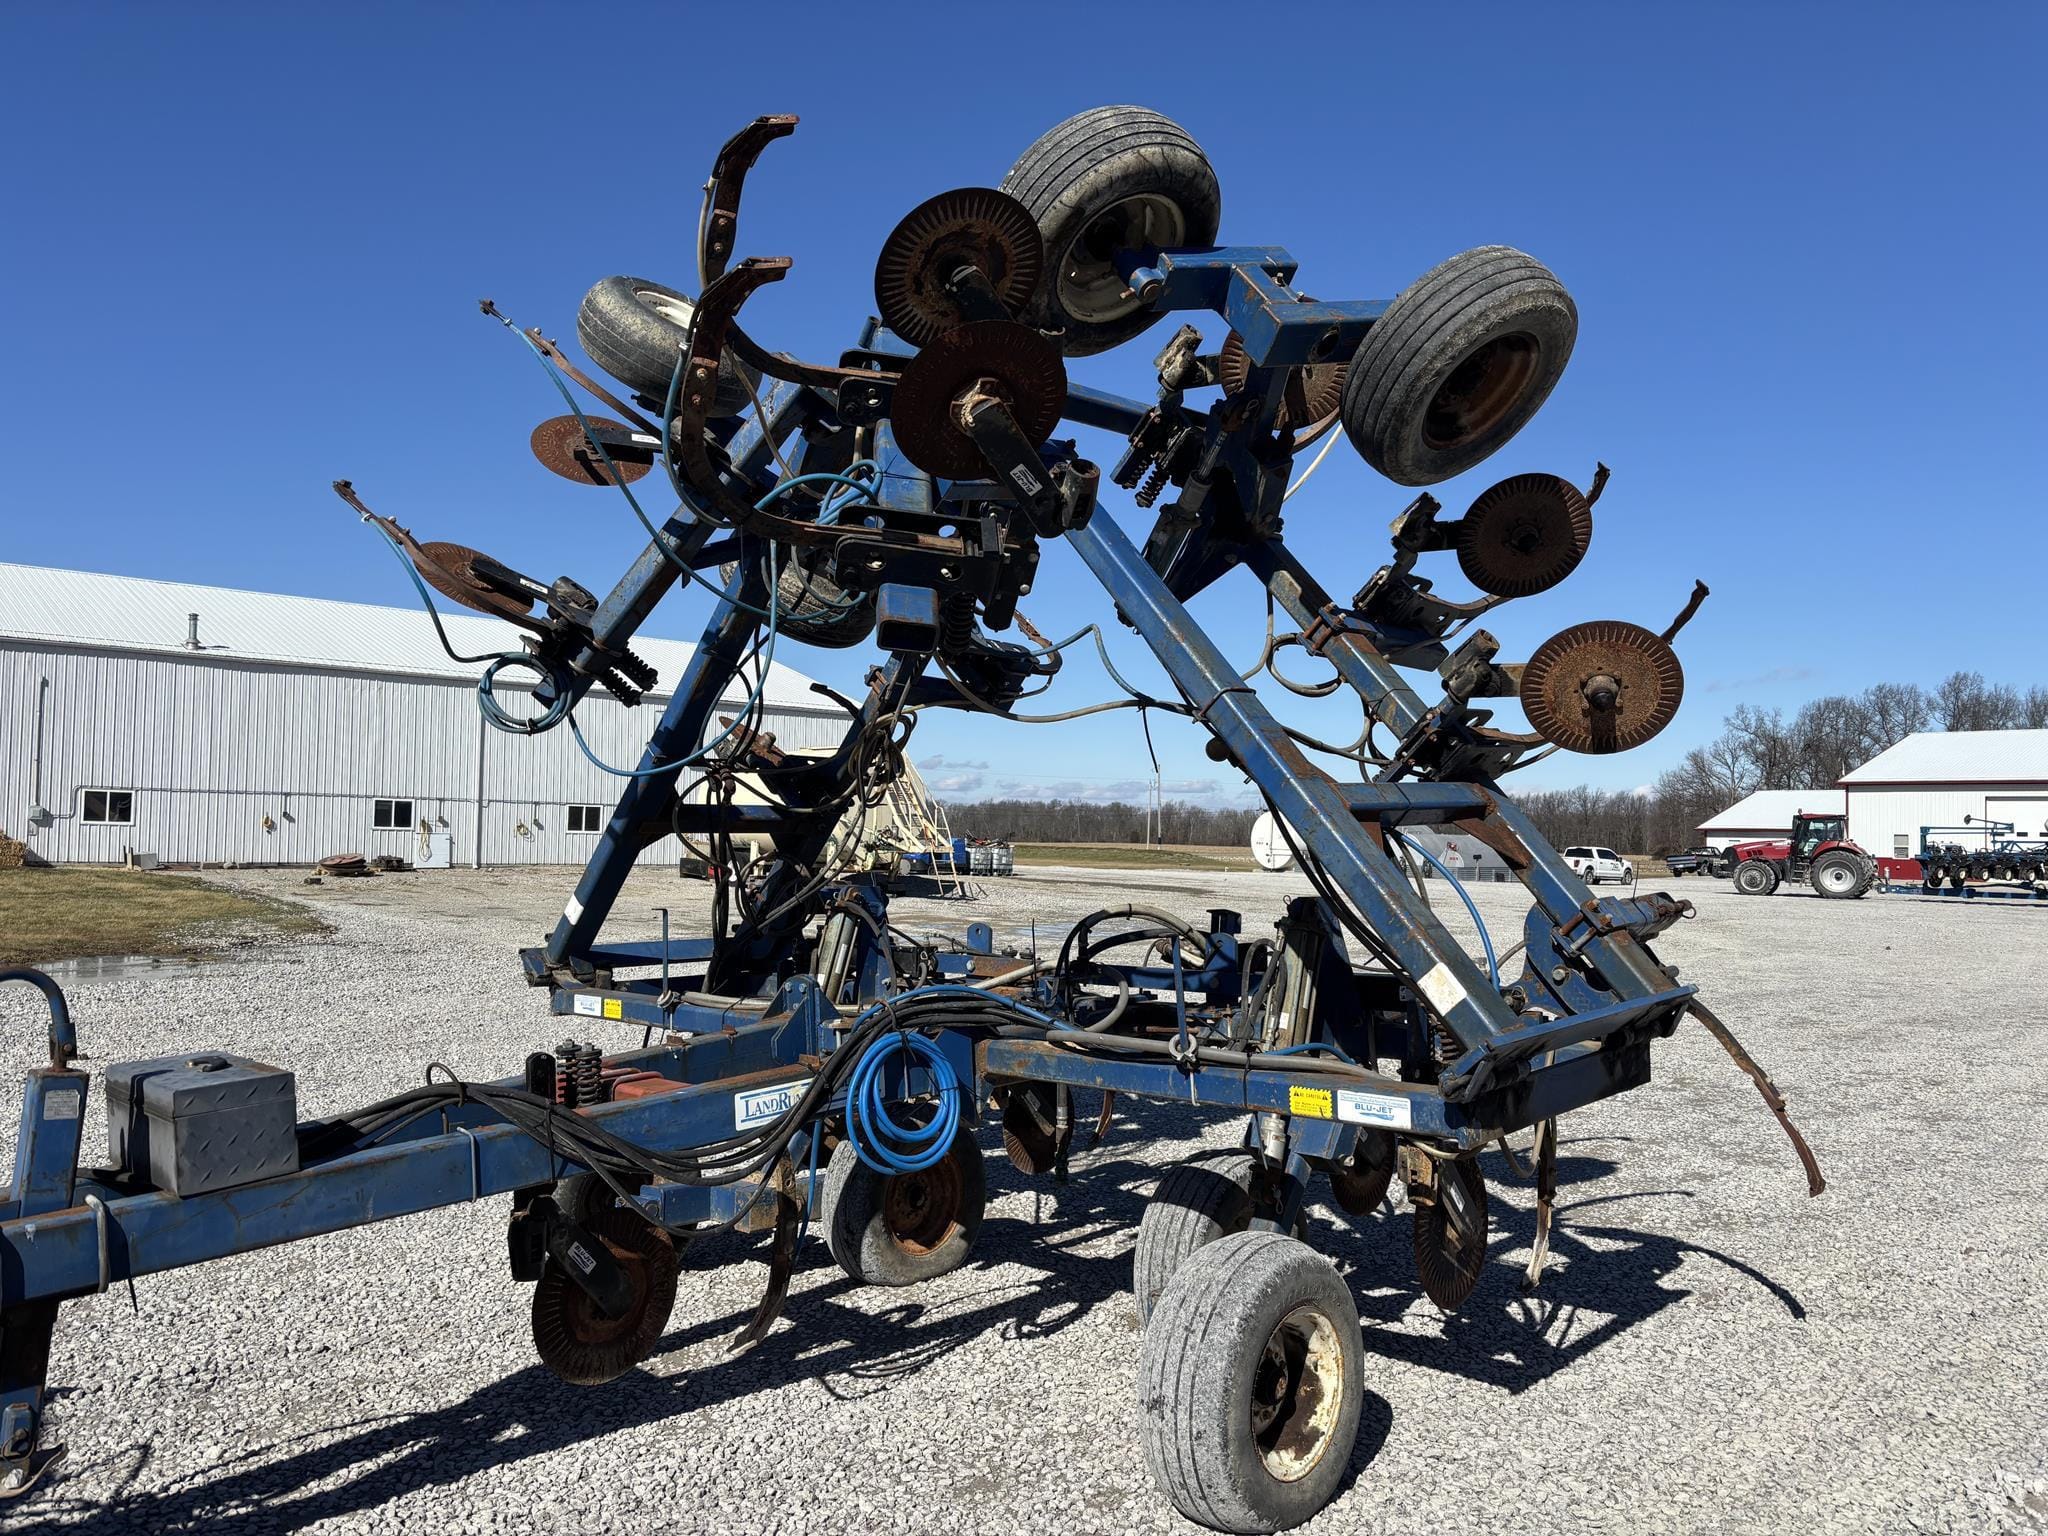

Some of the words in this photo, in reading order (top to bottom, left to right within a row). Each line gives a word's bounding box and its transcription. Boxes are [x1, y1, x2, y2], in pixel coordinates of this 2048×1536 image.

[1012, 471, 1033, 492] BLU-JET
[1354, 1102, 1393, 1114] BLU-JET
[575, 1245, 594, 1264] BLU-JET
